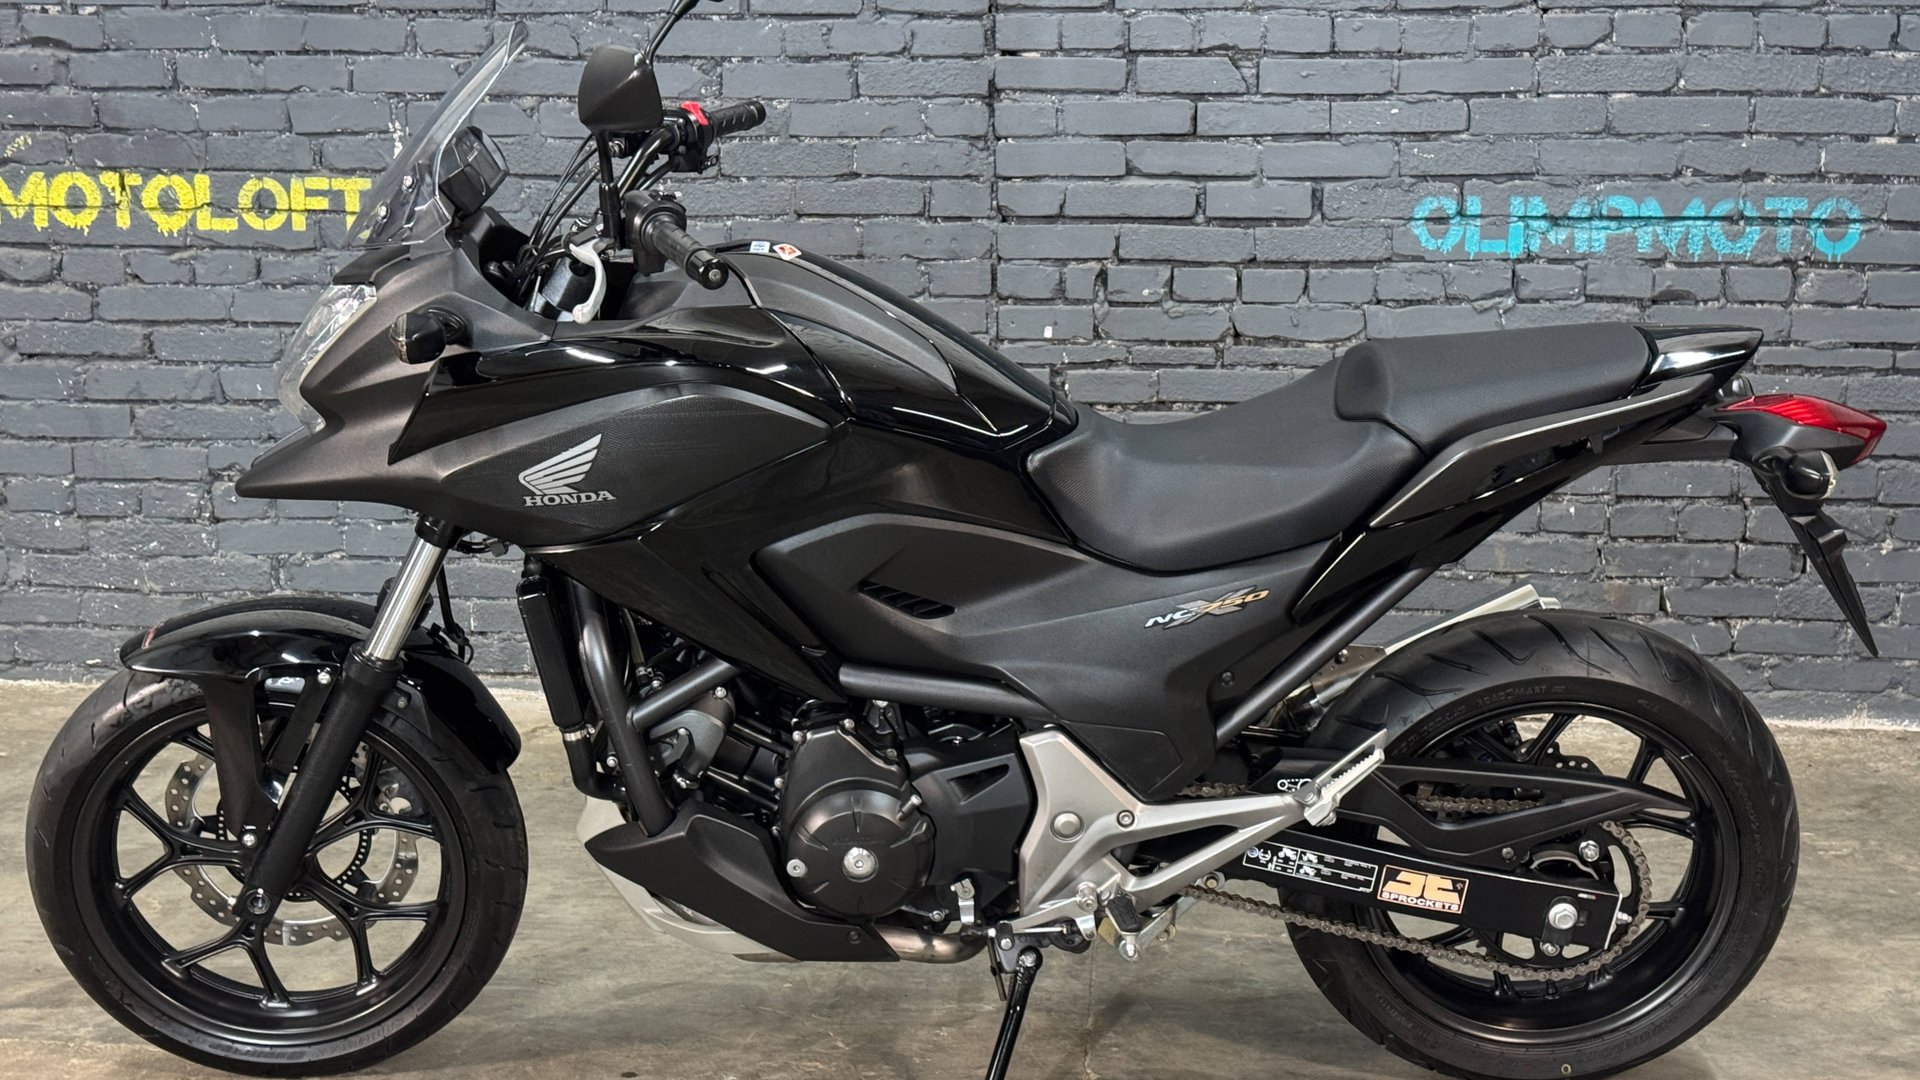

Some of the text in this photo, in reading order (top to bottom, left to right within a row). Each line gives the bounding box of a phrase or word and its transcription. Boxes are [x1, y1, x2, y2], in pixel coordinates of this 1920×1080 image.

[0, 171, 372, 237] MOTOLOFT
[1409, 195, 1864, 262] OLIMPMOTO
[523, 491, 617, 507] HONDA
[1381, 891, 1459, 911] SPROCKETS
